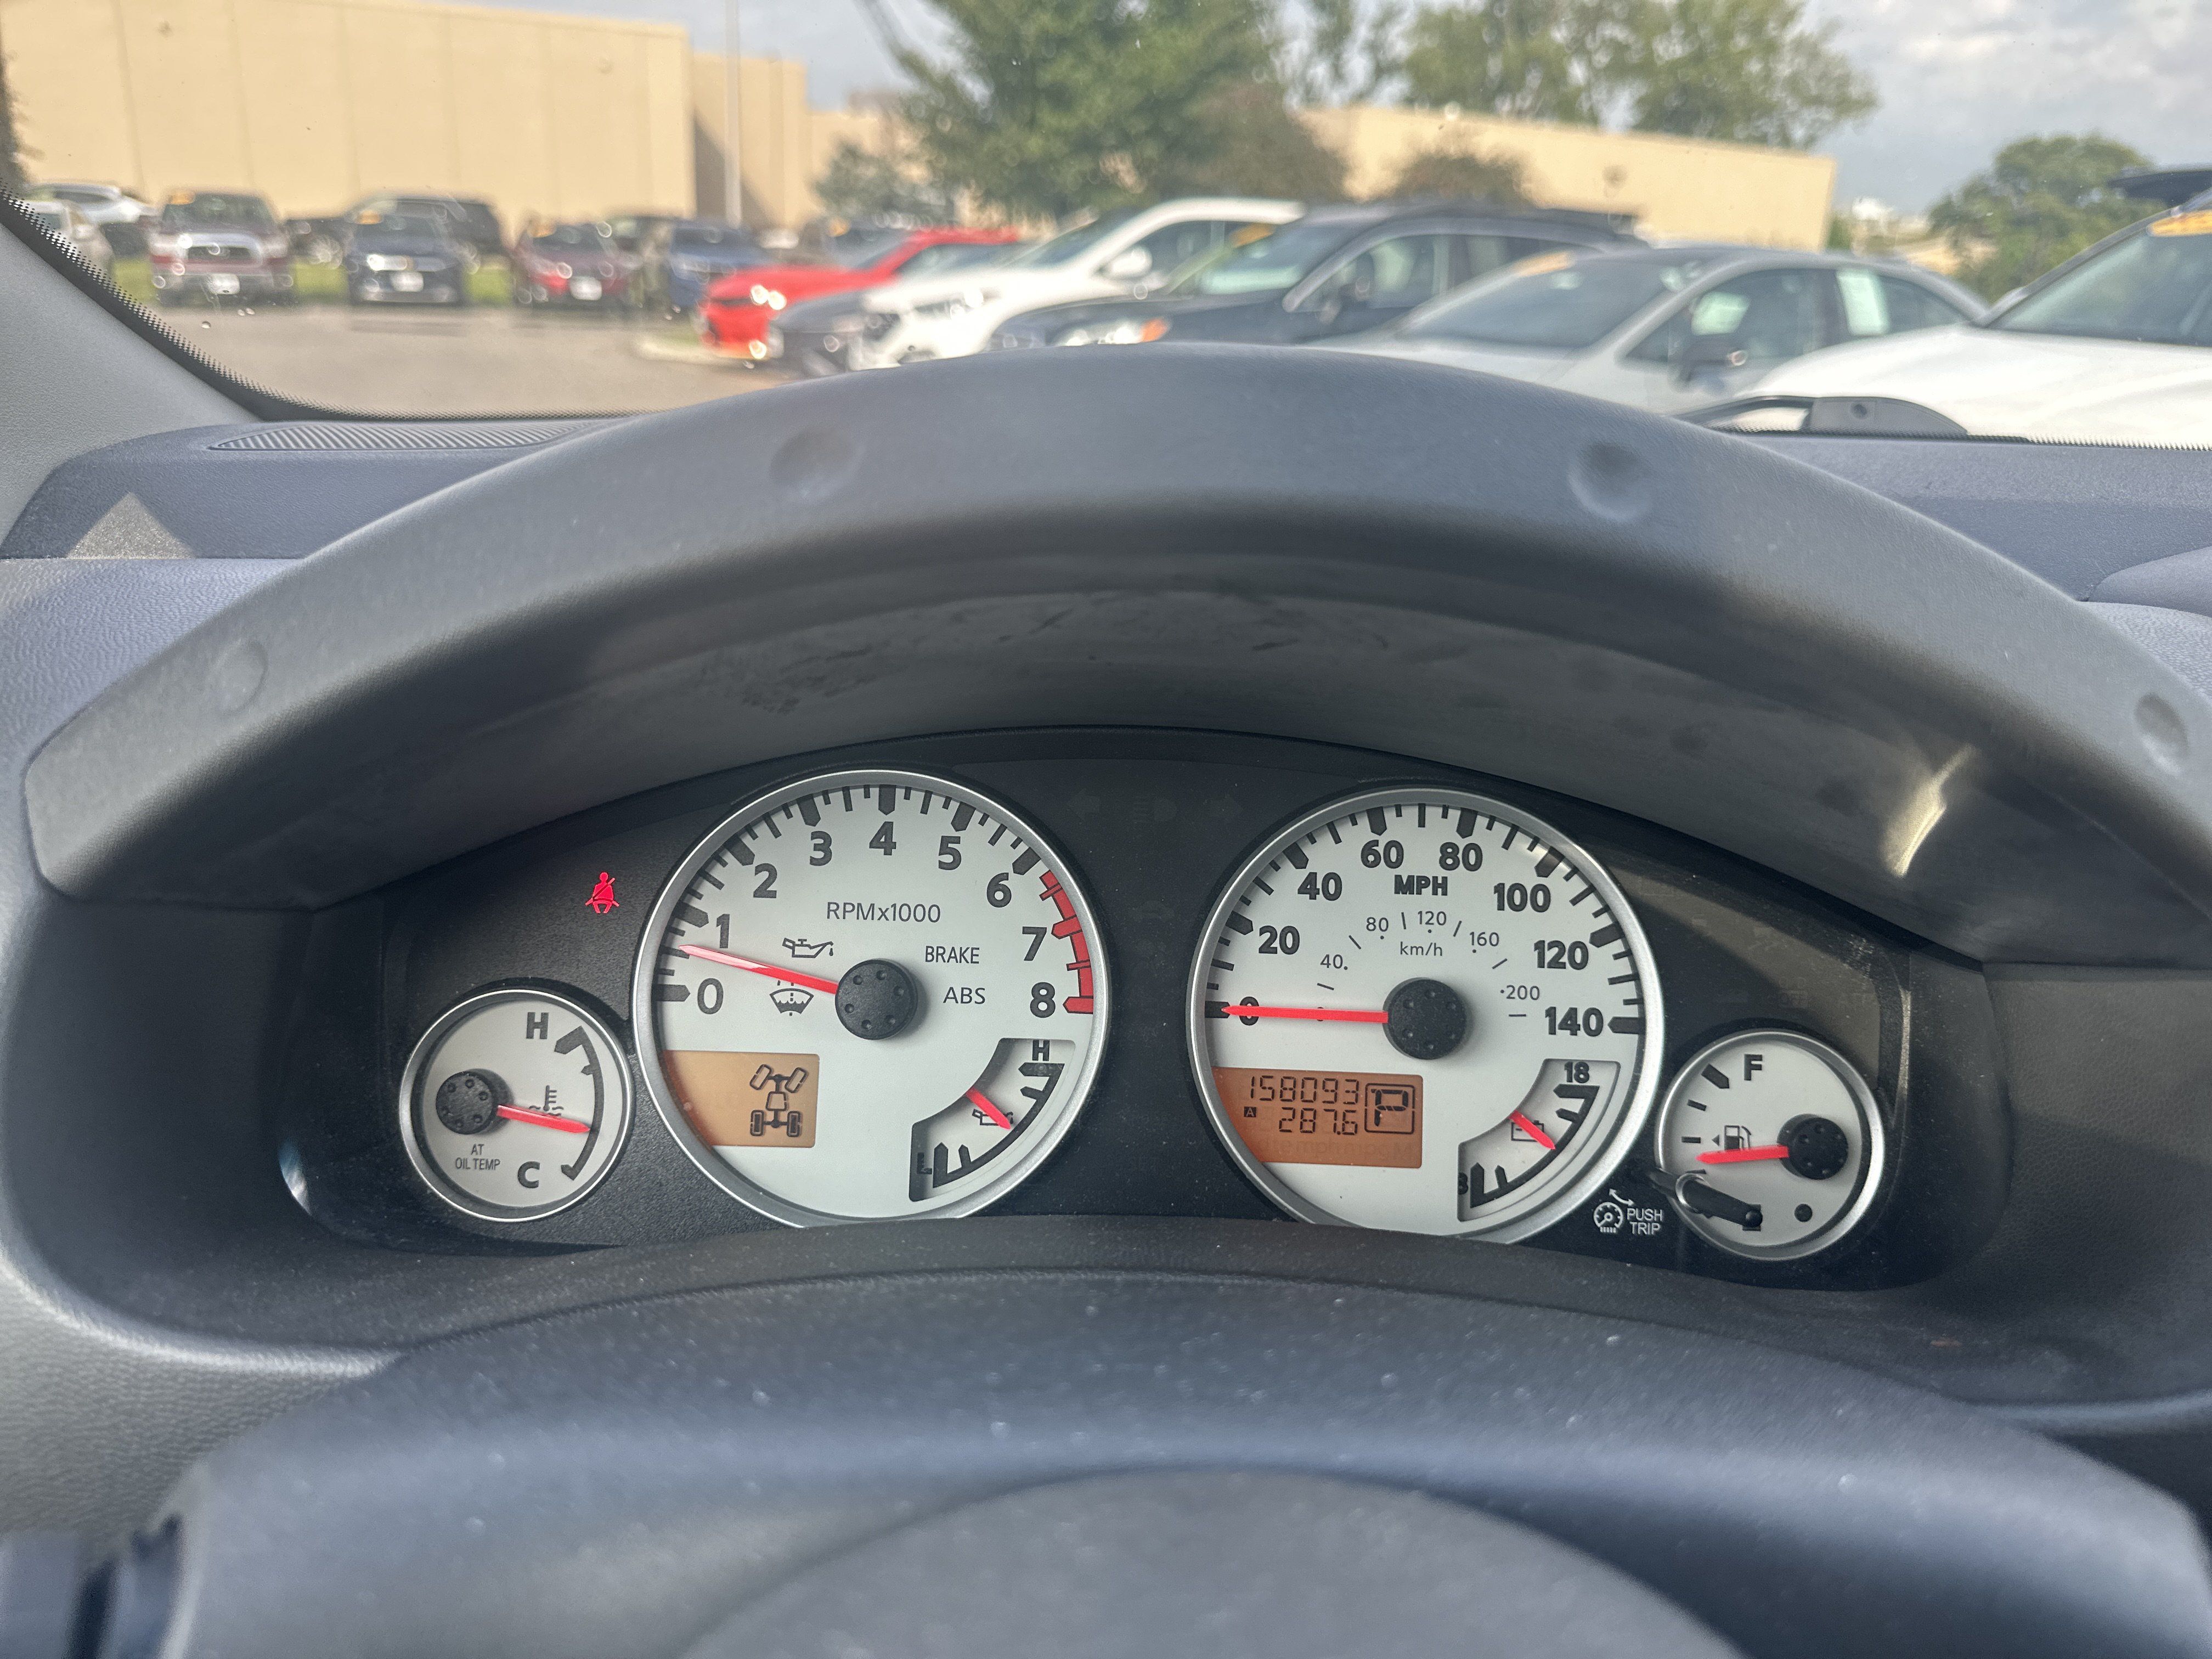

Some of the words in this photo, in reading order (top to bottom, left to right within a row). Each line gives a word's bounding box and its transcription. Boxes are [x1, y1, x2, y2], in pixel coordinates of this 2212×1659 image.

[809, 830, 833, 867] 3
[868, 821, 897, 856] 4
[938, 835, 962, 871] 5
[1360, 839, 1404, 870] 60
[1438, 842, 1483, 872] 80
[752, 863, 778, 899] 2
[986, 872, 1012, 908] 6
[1297, 872, 1342, 901] 40
[1393, 874, 1448, 896] MPH
[1493, 882, 1551, 913] 100
[715, 913, 730, 949] 1
[1365, 917, 1389, 932] 80
[1417, 910, 1447, 926] 120
[1022, 926, 1047, 961] 7
[1258, 925, 1300, 955] 20
[1400, 941, 1443, 956] km/h
[1469, 931, 1500, 947] 160
[925, 945, 980, 964] BRAKE
[1320, 954, 1343, 969] 40
[1533, 940, 1589, 970] 120
[697, 978, 724, 1015] 0
[943, 986, 986, 1005] ABS
[1029, 981, 1056, 1018] 8
[1506, 984, 1540, 1001] 200
[526, 1012, 549, 1040] H
[1545, 1006, 1604, 1037] 140
[1032, 1040, 1050, 1062] H
[1564, 1062, 1589, 1083] 18
[1743, 1053, 1763, 1081] F
[1250, 1075, 1359, 1105] 158093
[1244, 1107, 1256, 1118] A
[1278, 1107, 1358, 1135] 287.6
[1371, 1089, 1408, 1126] P
[470, 1143, 484, 1155] AT
[455, 1157, 471, 1170] OIL
[472, 1158, 501, 1171] TEMP
[517, 1161, 540, 1189] C
[1627, 1207, 1663, 1222] PUSH
[1629, 1222, 1661, 1235] TRIP
